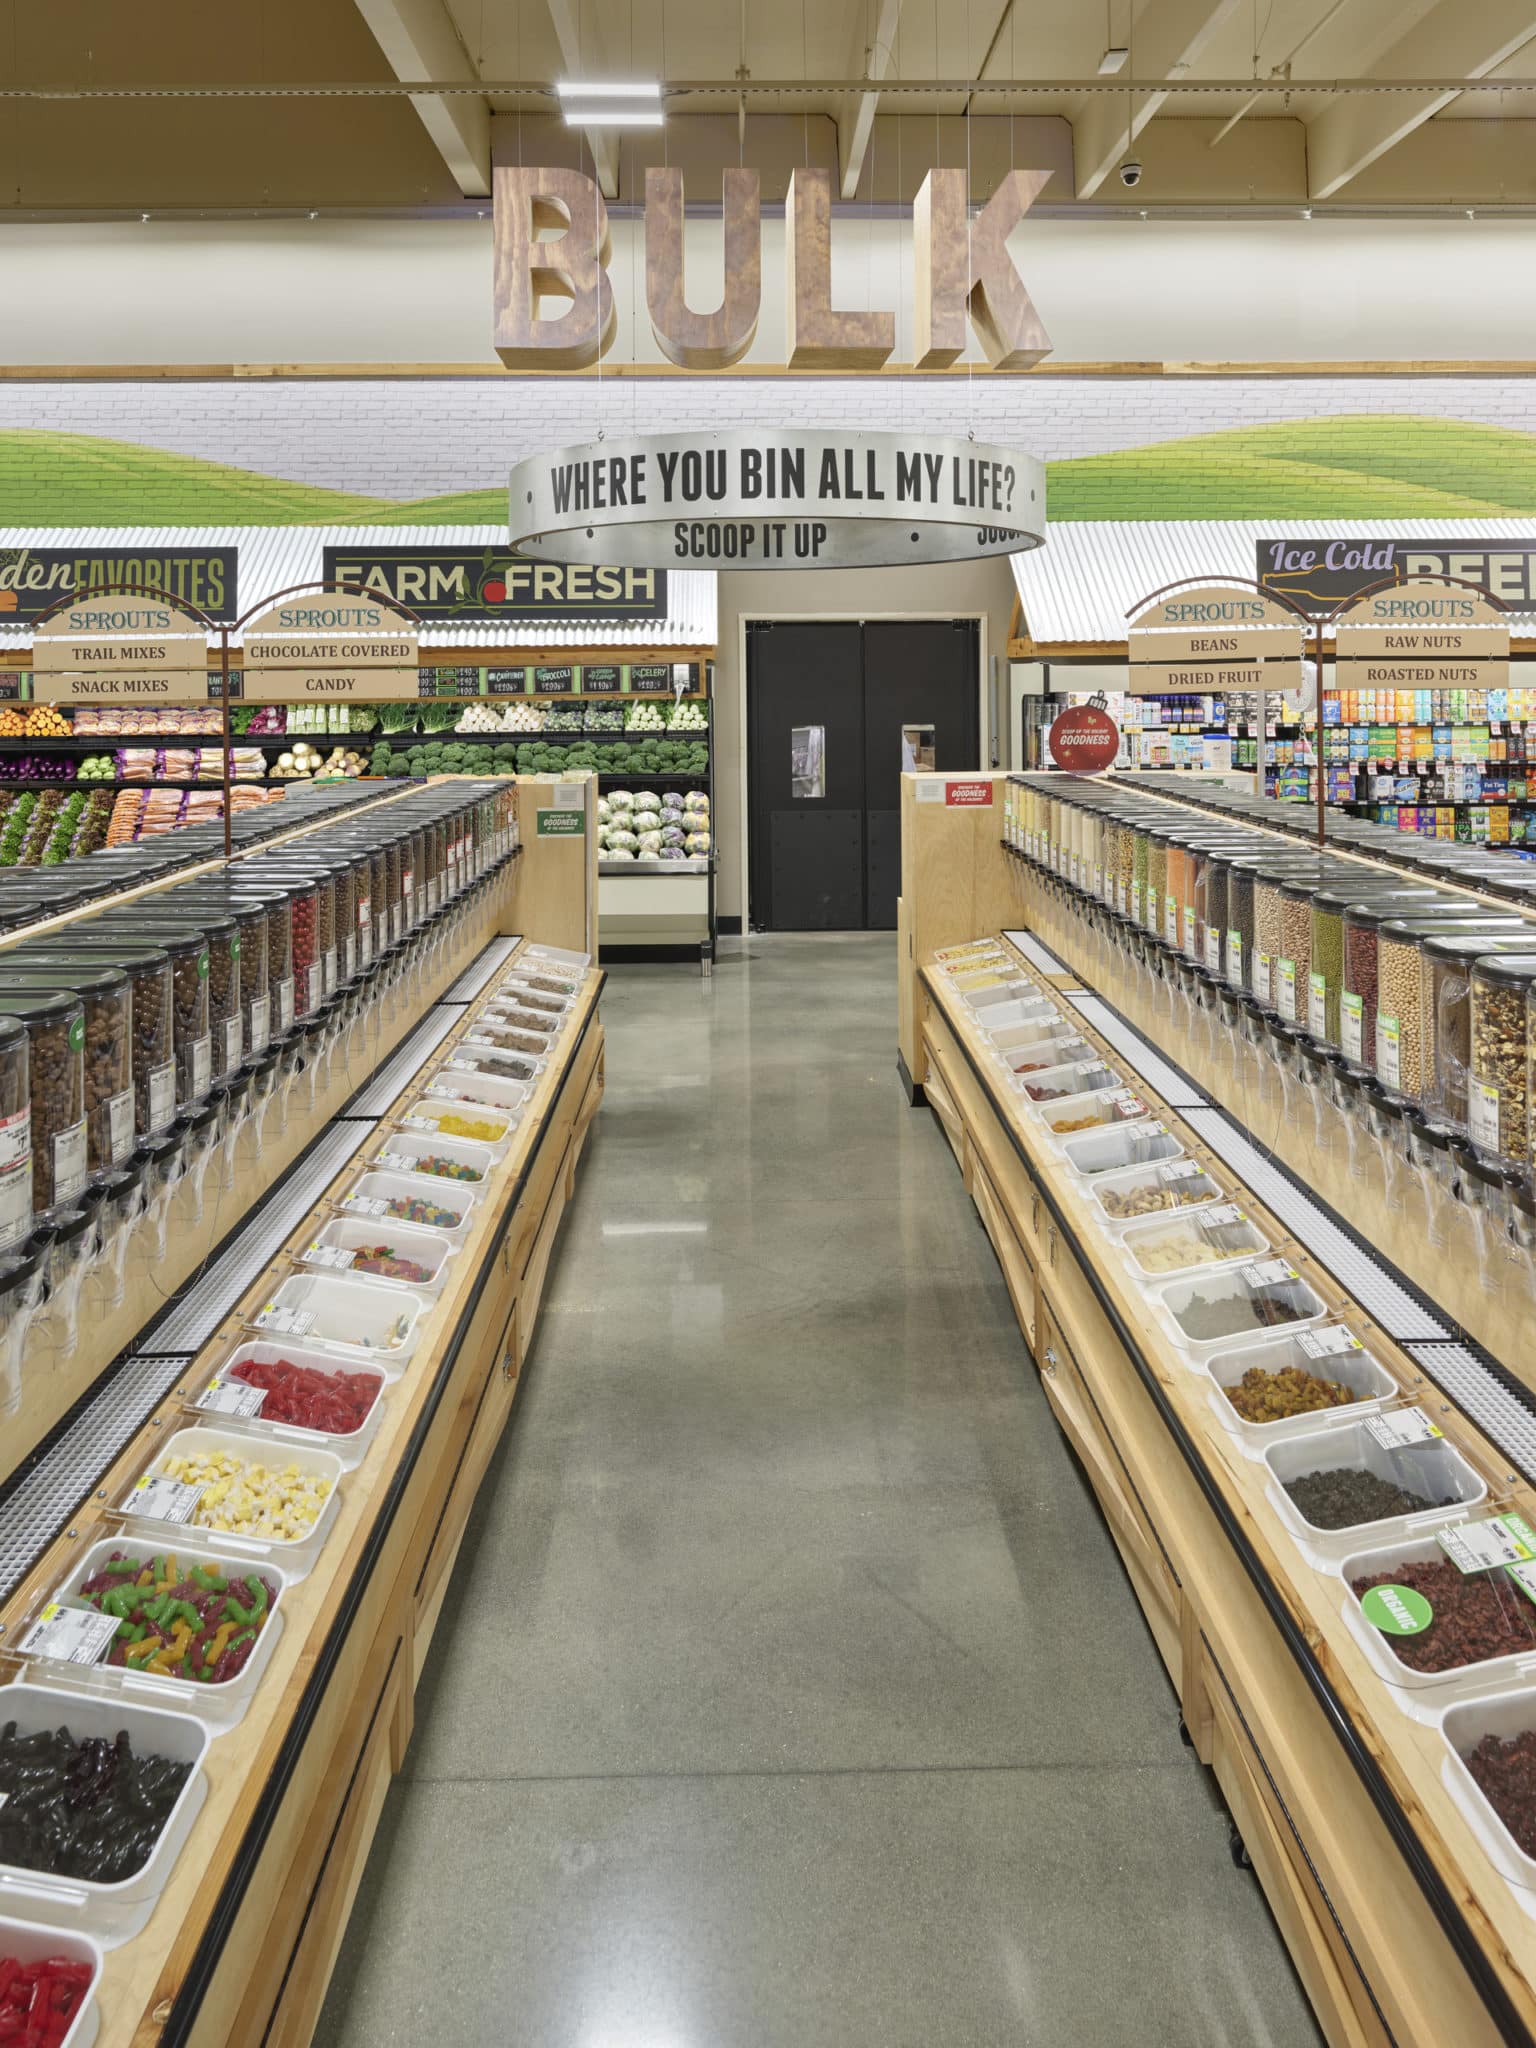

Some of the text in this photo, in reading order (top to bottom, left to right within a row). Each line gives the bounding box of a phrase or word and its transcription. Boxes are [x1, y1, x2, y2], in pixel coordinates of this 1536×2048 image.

[493, 167, 1055, 369] BULK
[551, 448, 1015, 514] WHERE YOU BIN ALL MY LIFE?
[674, 522, 827, 559] SCOOP IT UP
[1269, 541, 1536, 601] Ice Cold BEE
[73, 558, 224, 608] FAVORITES
[336, 566, 655, 600] FARM FRESH
[1164, 601, 1266, 623] SPROUTS
[1373, 599, 1475, 620] SPROUTS
[69, 610, 171, 631] SPROUTS
[279, 608, 381, 630] SPROUTS
[1190, 639, 1238, 652] BEANS
[1384, 635, 1462, 649] RAW NUTS
[72, 647, 166, 660] TRAIL MIXES
[250, 645, 410, 658] CHOCOLATE COVERED
[640, 668, 667, 678] CELERY
[1168, 670, 1263, 686] DRIED FRUIT
[1367, 668, 1478, 681] ROASTED NUTS
[72, 679, 169, 693] SNACK MIXES
[305, 678, 356, 691] CANDY
[1060, 735, 1110, 745] GOODNESS
[952, 790, 987, 798] GOODNESS
[544, 818, 578, 827] GOODNESS
[1455, 824, 1470, 832] IPA
[1377, 1589, 1418, 1630] ORGANIC
